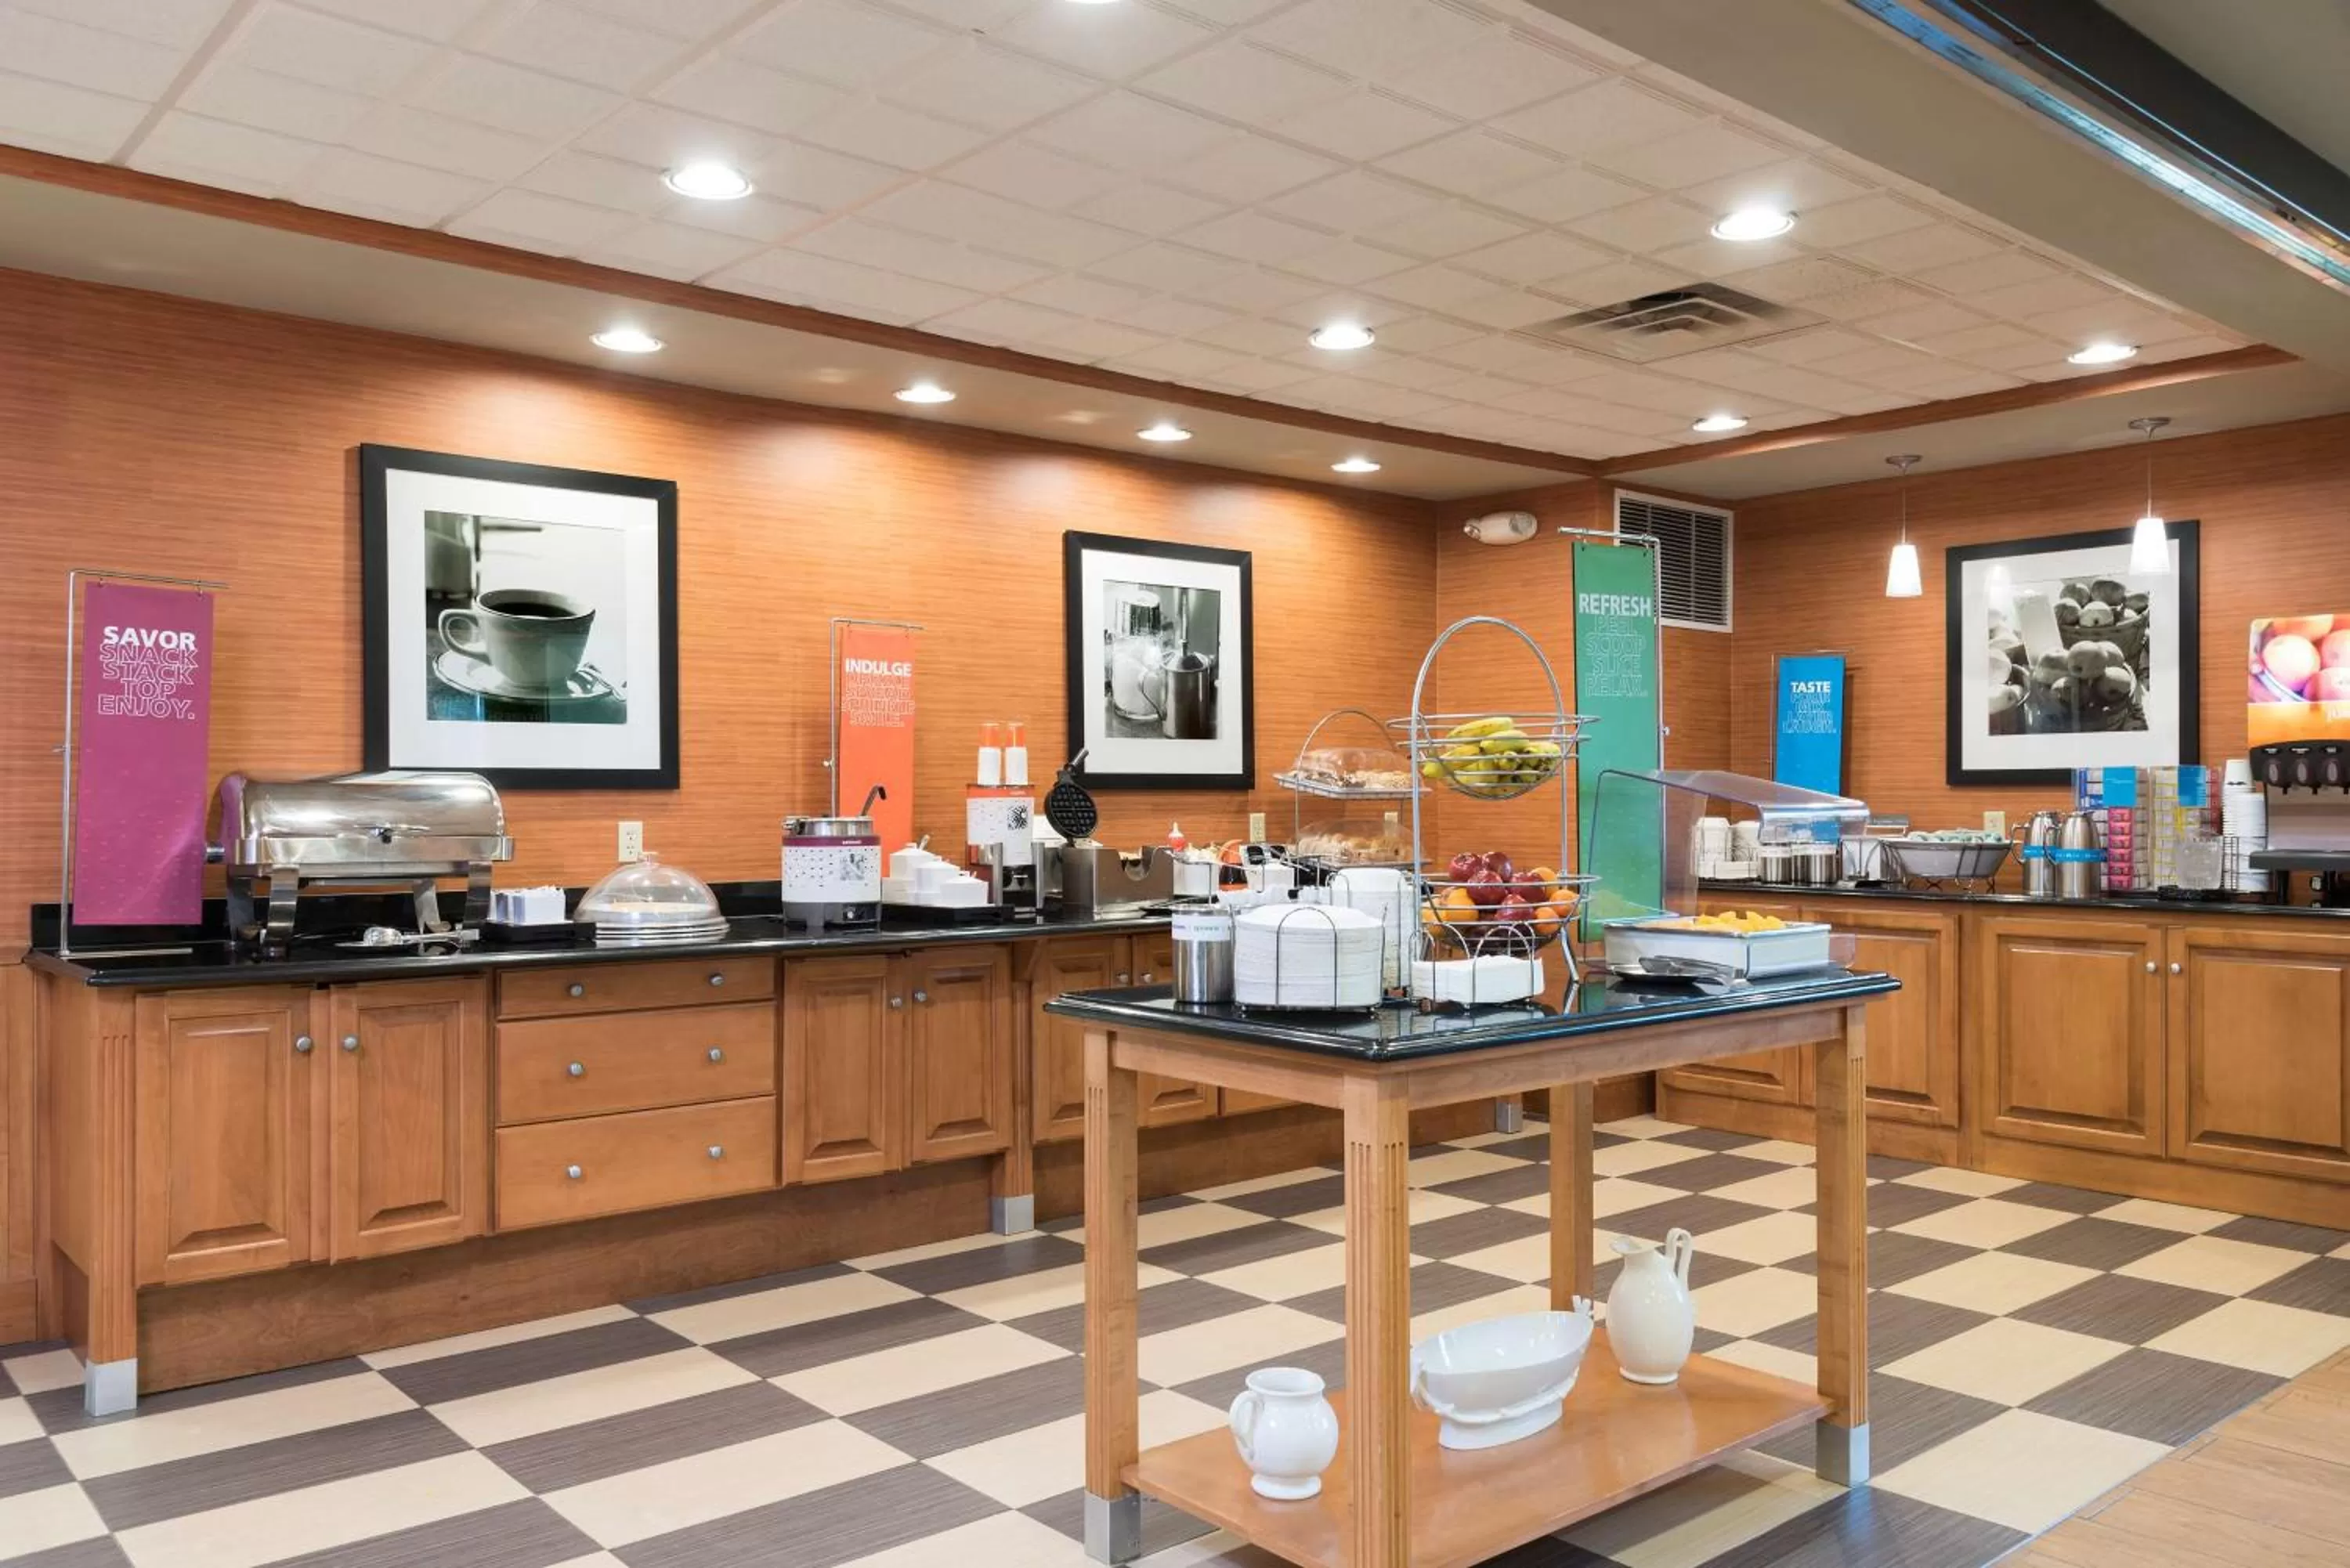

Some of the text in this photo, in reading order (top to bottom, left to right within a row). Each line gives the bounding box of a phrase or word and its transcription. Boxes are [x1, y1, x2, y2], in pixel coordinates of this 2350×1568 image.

[1578, 593, 1651, 617] REFRESH
[103, 626, 196, 650] SAVOR
[99, 643, 198, 668] SNACK
[845, 658, 912, 677] INDULGE
[103, 660, 194, 685] STACK
[120, 678, 176, 700] TOP
[1791, 681, 1831, 693] TASTE
[98, 693, 195, 719] ENJOY.
